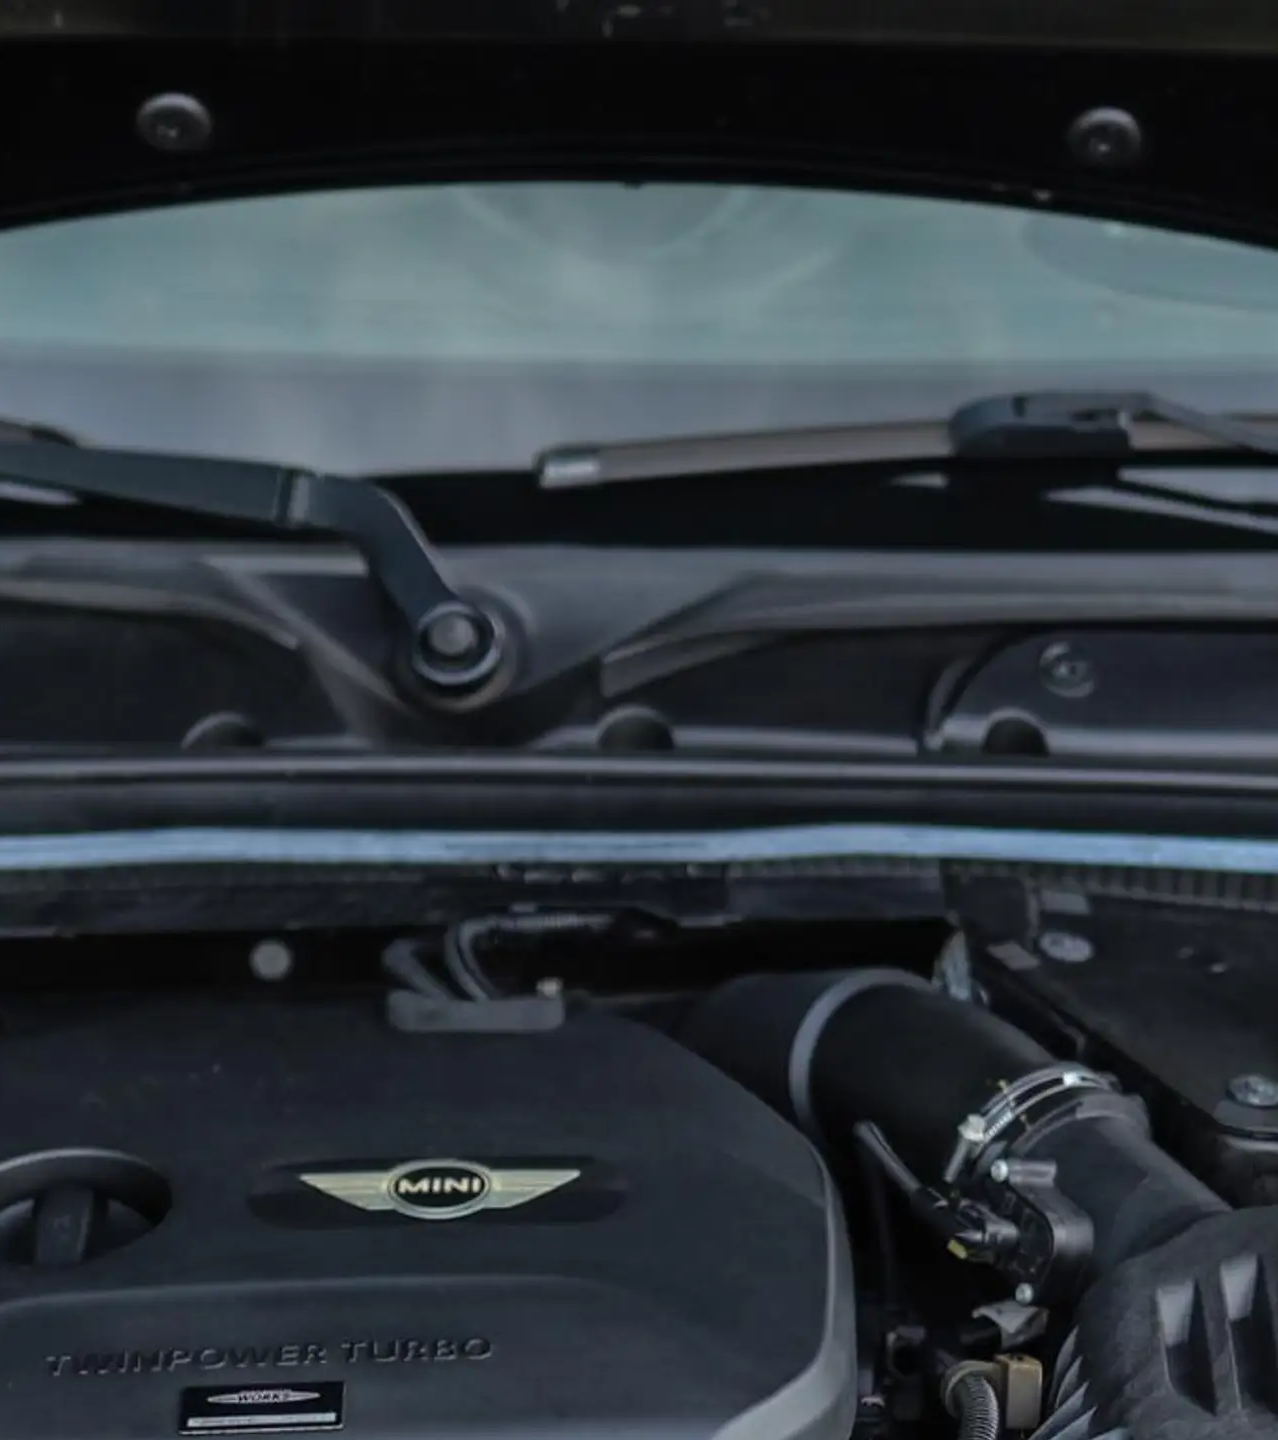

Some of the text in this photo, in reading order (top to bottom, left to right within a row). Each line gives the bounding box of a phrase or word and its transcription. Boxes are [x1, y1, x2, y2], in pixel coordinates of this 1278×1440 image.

[398, 1177, 481, 1194] MINI
[45, 1337, 493, 1377] TWINPOWER TURBO
